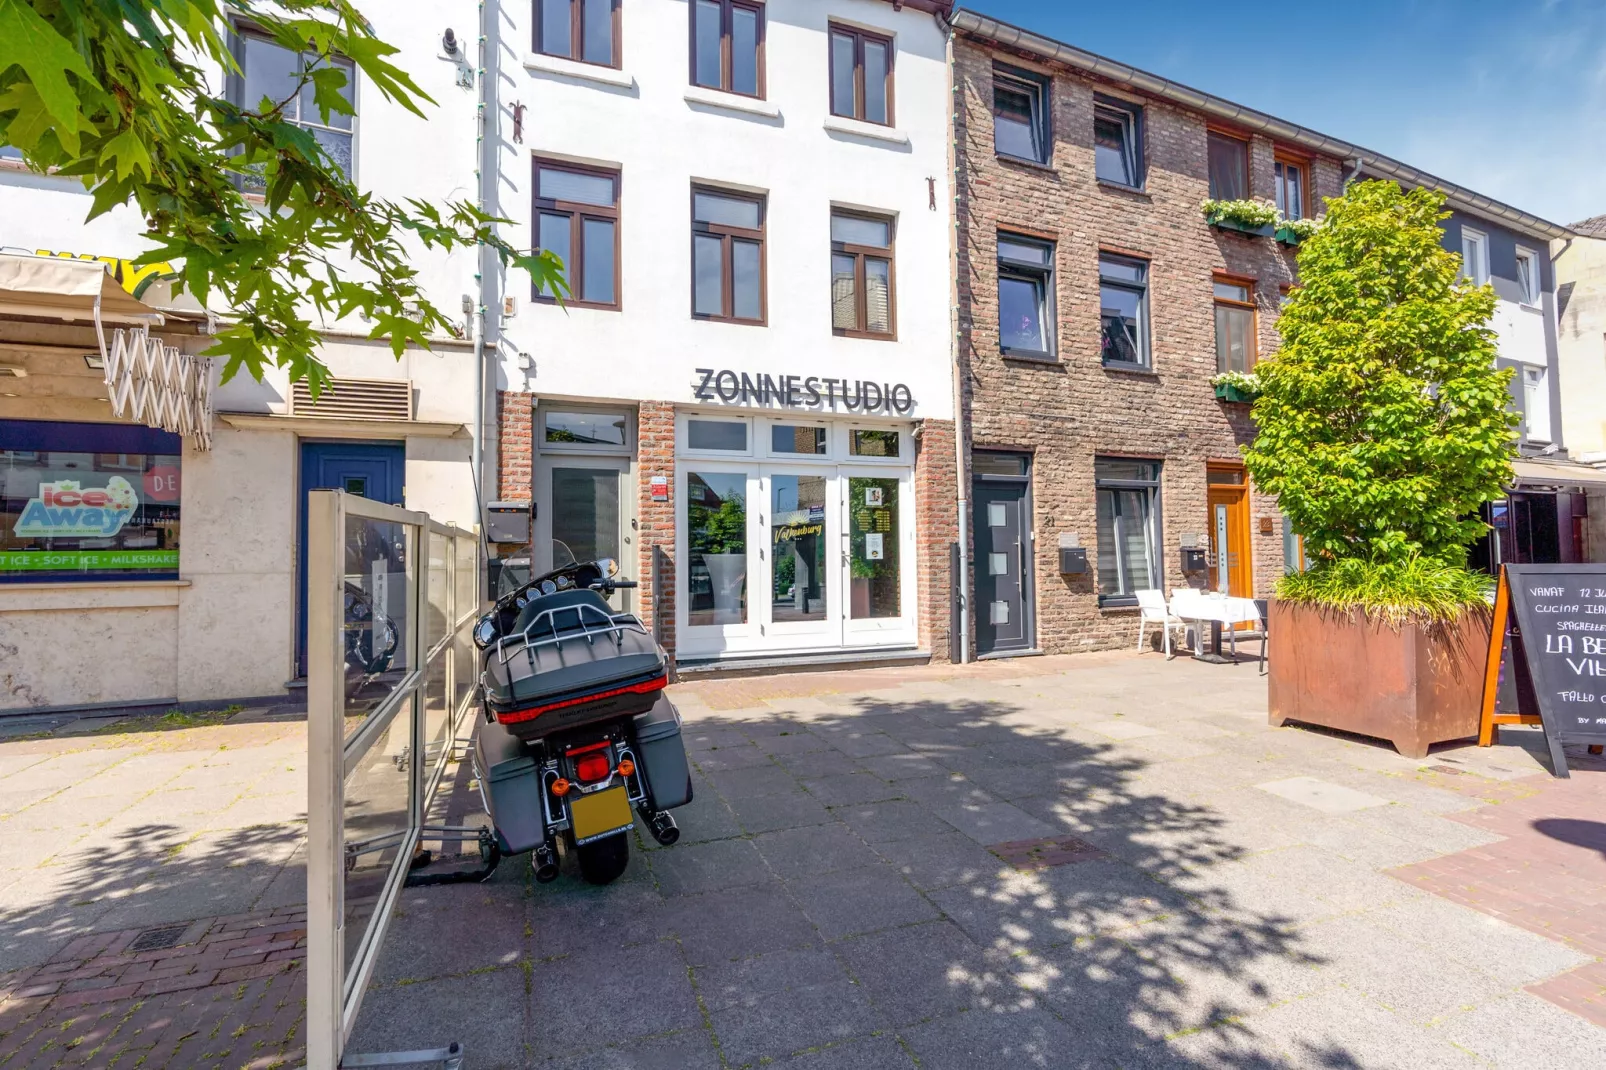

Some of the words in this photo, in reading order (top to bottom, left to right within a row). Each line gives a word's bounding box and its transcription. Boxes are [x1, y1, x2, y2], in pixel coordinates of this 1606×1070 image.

[695, 368, 912, 412] ZONNESTUDIO
[21, 501, 131, 534] Away
[11, 555, 30, 565] ICE
[43, 555, 76, 565] SOFT
[80, 555, 99, 565] ICE
[1529, 587, 1565, 597] VANAF
[1580, 588, 1591, 598] 12
[1546, 634, 1573, 654] LA
